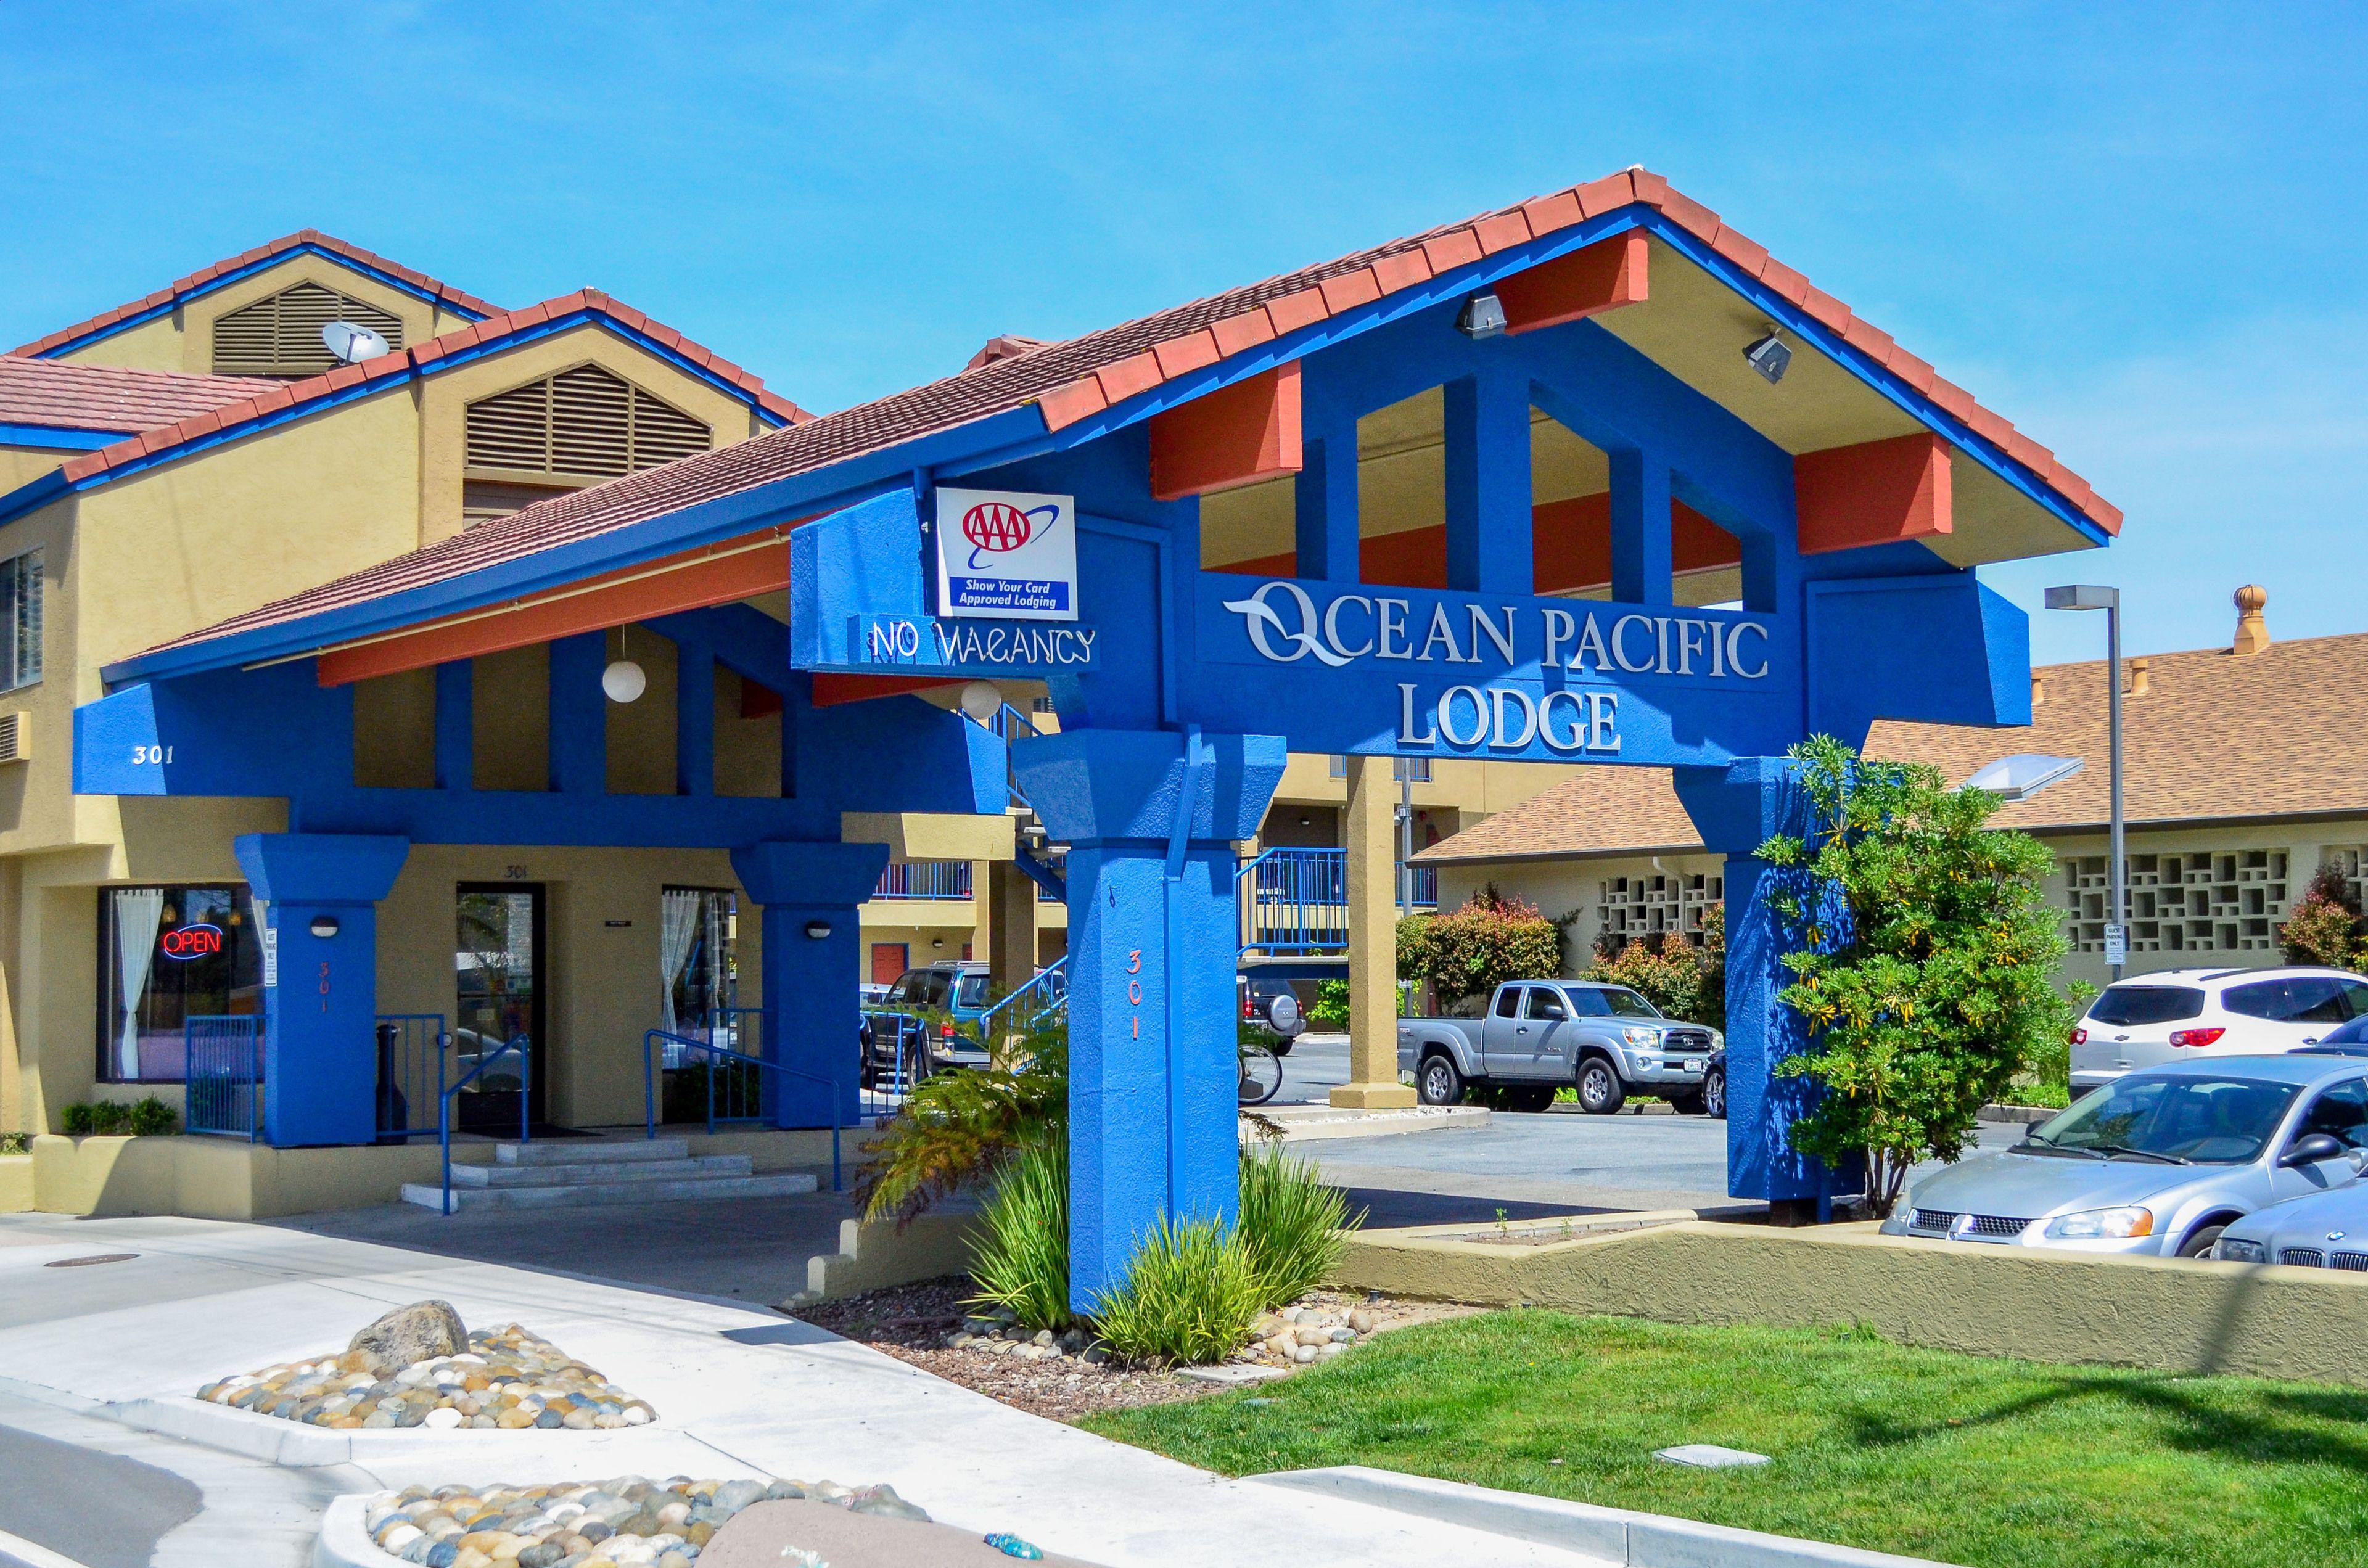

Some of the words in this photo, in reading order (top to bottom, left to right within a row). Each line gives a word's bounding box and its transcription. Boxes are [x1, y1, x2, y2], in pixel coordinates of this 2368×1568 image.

[963, 503, 1030, 551] AAA
[959, 593, 1011, 607] Approved
[1014, 595, 1056, 609] Lodging
[966, 579, 995, 591] Show
[998, 581, 1022, 593] Your
[1026, 582, 1050, 594] Card
[873, 621, 919, 657] NO
[935, 623, 1096, 664] VACANCY
[1246, 581, 1518, 666] OCEAN
[1541, 609, 1769, 678] PACIFIC
[1397, 683, 1621, 751] LODGE
[133, 745, 173, 765] 301
[504, 865, 527, 878] 301
[164, 932, 221, 952] OPEN
[1126, 950, 1141, 1039] 301
